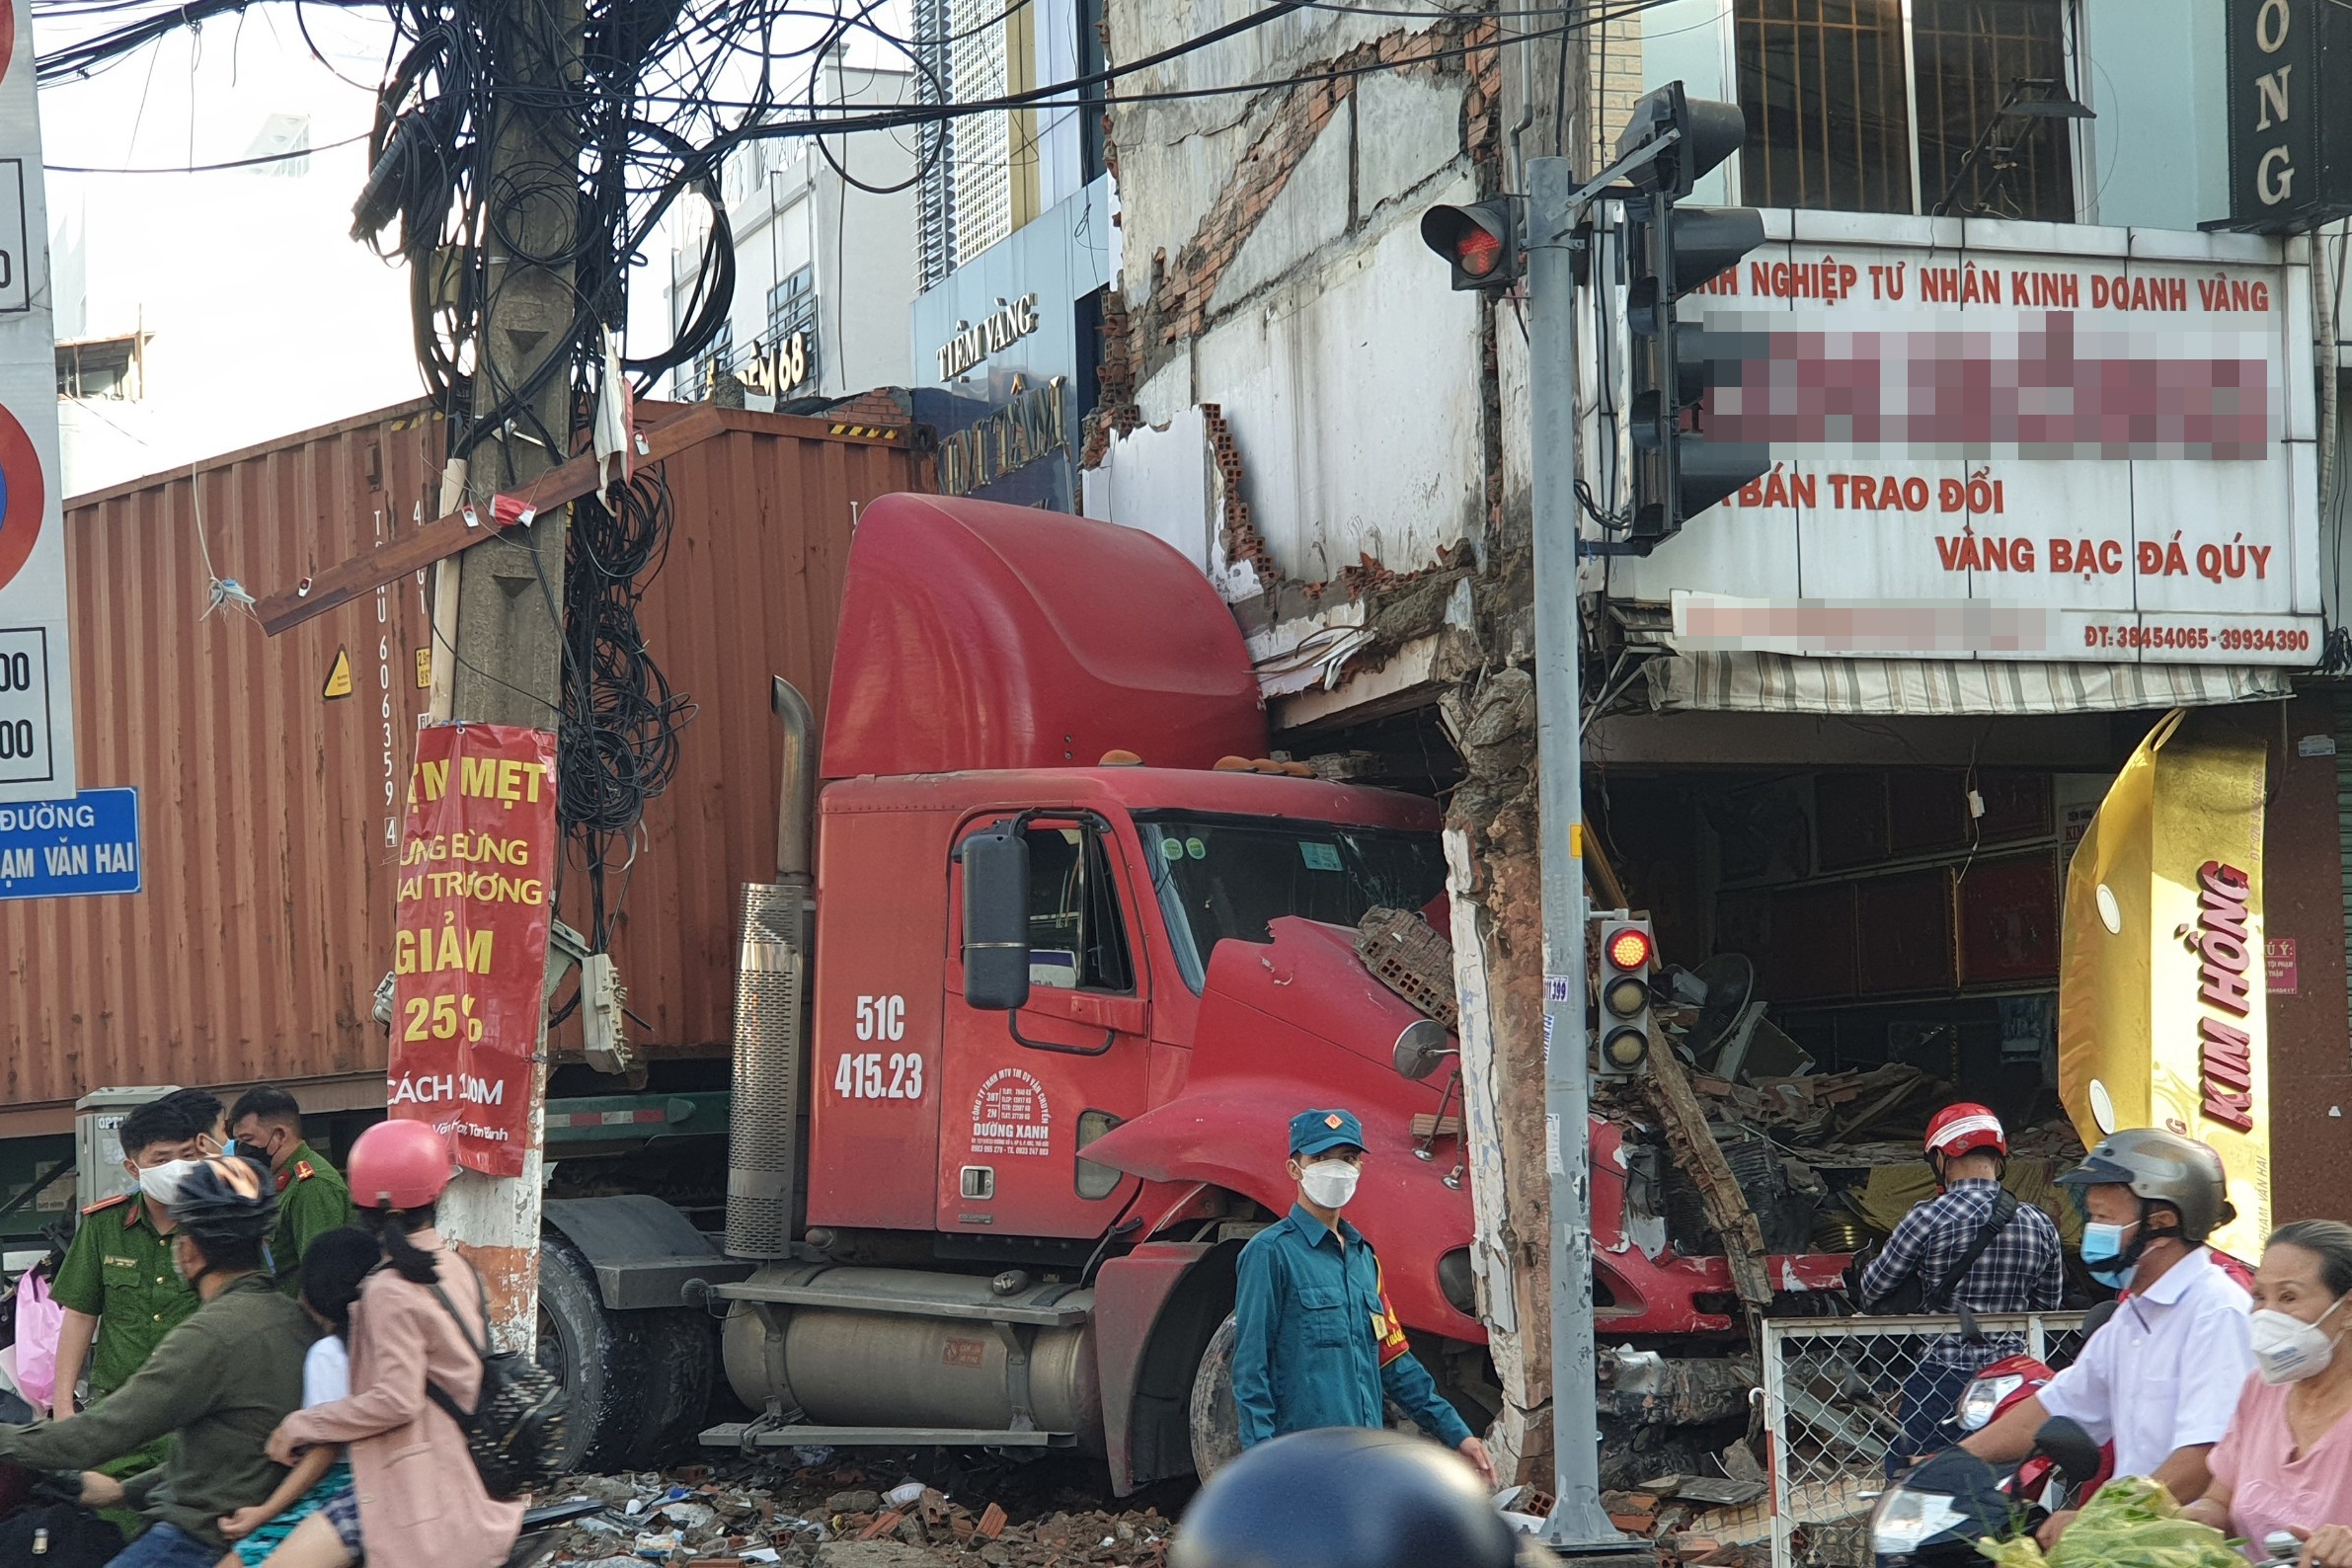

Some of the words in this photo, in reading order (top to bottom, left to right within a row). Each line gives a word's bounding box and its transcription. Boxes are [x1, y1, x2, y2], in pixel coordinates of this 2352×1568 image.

[1751, 255, 1857, 307] NGHIỆP
[1868, 260, 1906, 302] TƯ
[1921, 261, 2000, 306] NHÂN
[2012, 272, 2079, 309] KINH
[2092, 275, 2187, 312] DOANH
[2197, 272, 2269, 312] VÀNG
[779, 331, 806, 392] 68
[936, 320, 987, 383] TIỆM
[983, 292, 1040, 353] VÀNG
[1739, 461, 1817, 509] BÁN
[1828, 474, 1929, 512] TRAO
[1938, 466, 2004, 514] ĐỔI
[1936, 525, 2035, 574] VÀNG
[2049, 540, 2123, 583] BẠC
[2137, 530, 2188, 577] ĐÁ
[2196, 532, 2272, 580] QÚY
[2084, 625, 2113, 648] ĐT:
[460, 756, 547, 810] MẸT
[0, 802, 95, 832] ĐƯỜNG
[43, 835, 89, 877] VĂN
[95, 841, 135, 874] HAI
[395, 910, 494, 975] GIẢM
[2173, 860, 2250, 1019] HỒNG
[404, 993, 484, 1043] 25%
[856, 995, 904, 1042] 51C
[834, 1053, 923, 1100] 415.23
[2200, 1015, 2253, 1135] KIM
[1015, 1124, 1049, 1139] XANH
[2256, 1154, 2268, 1177] HAI
